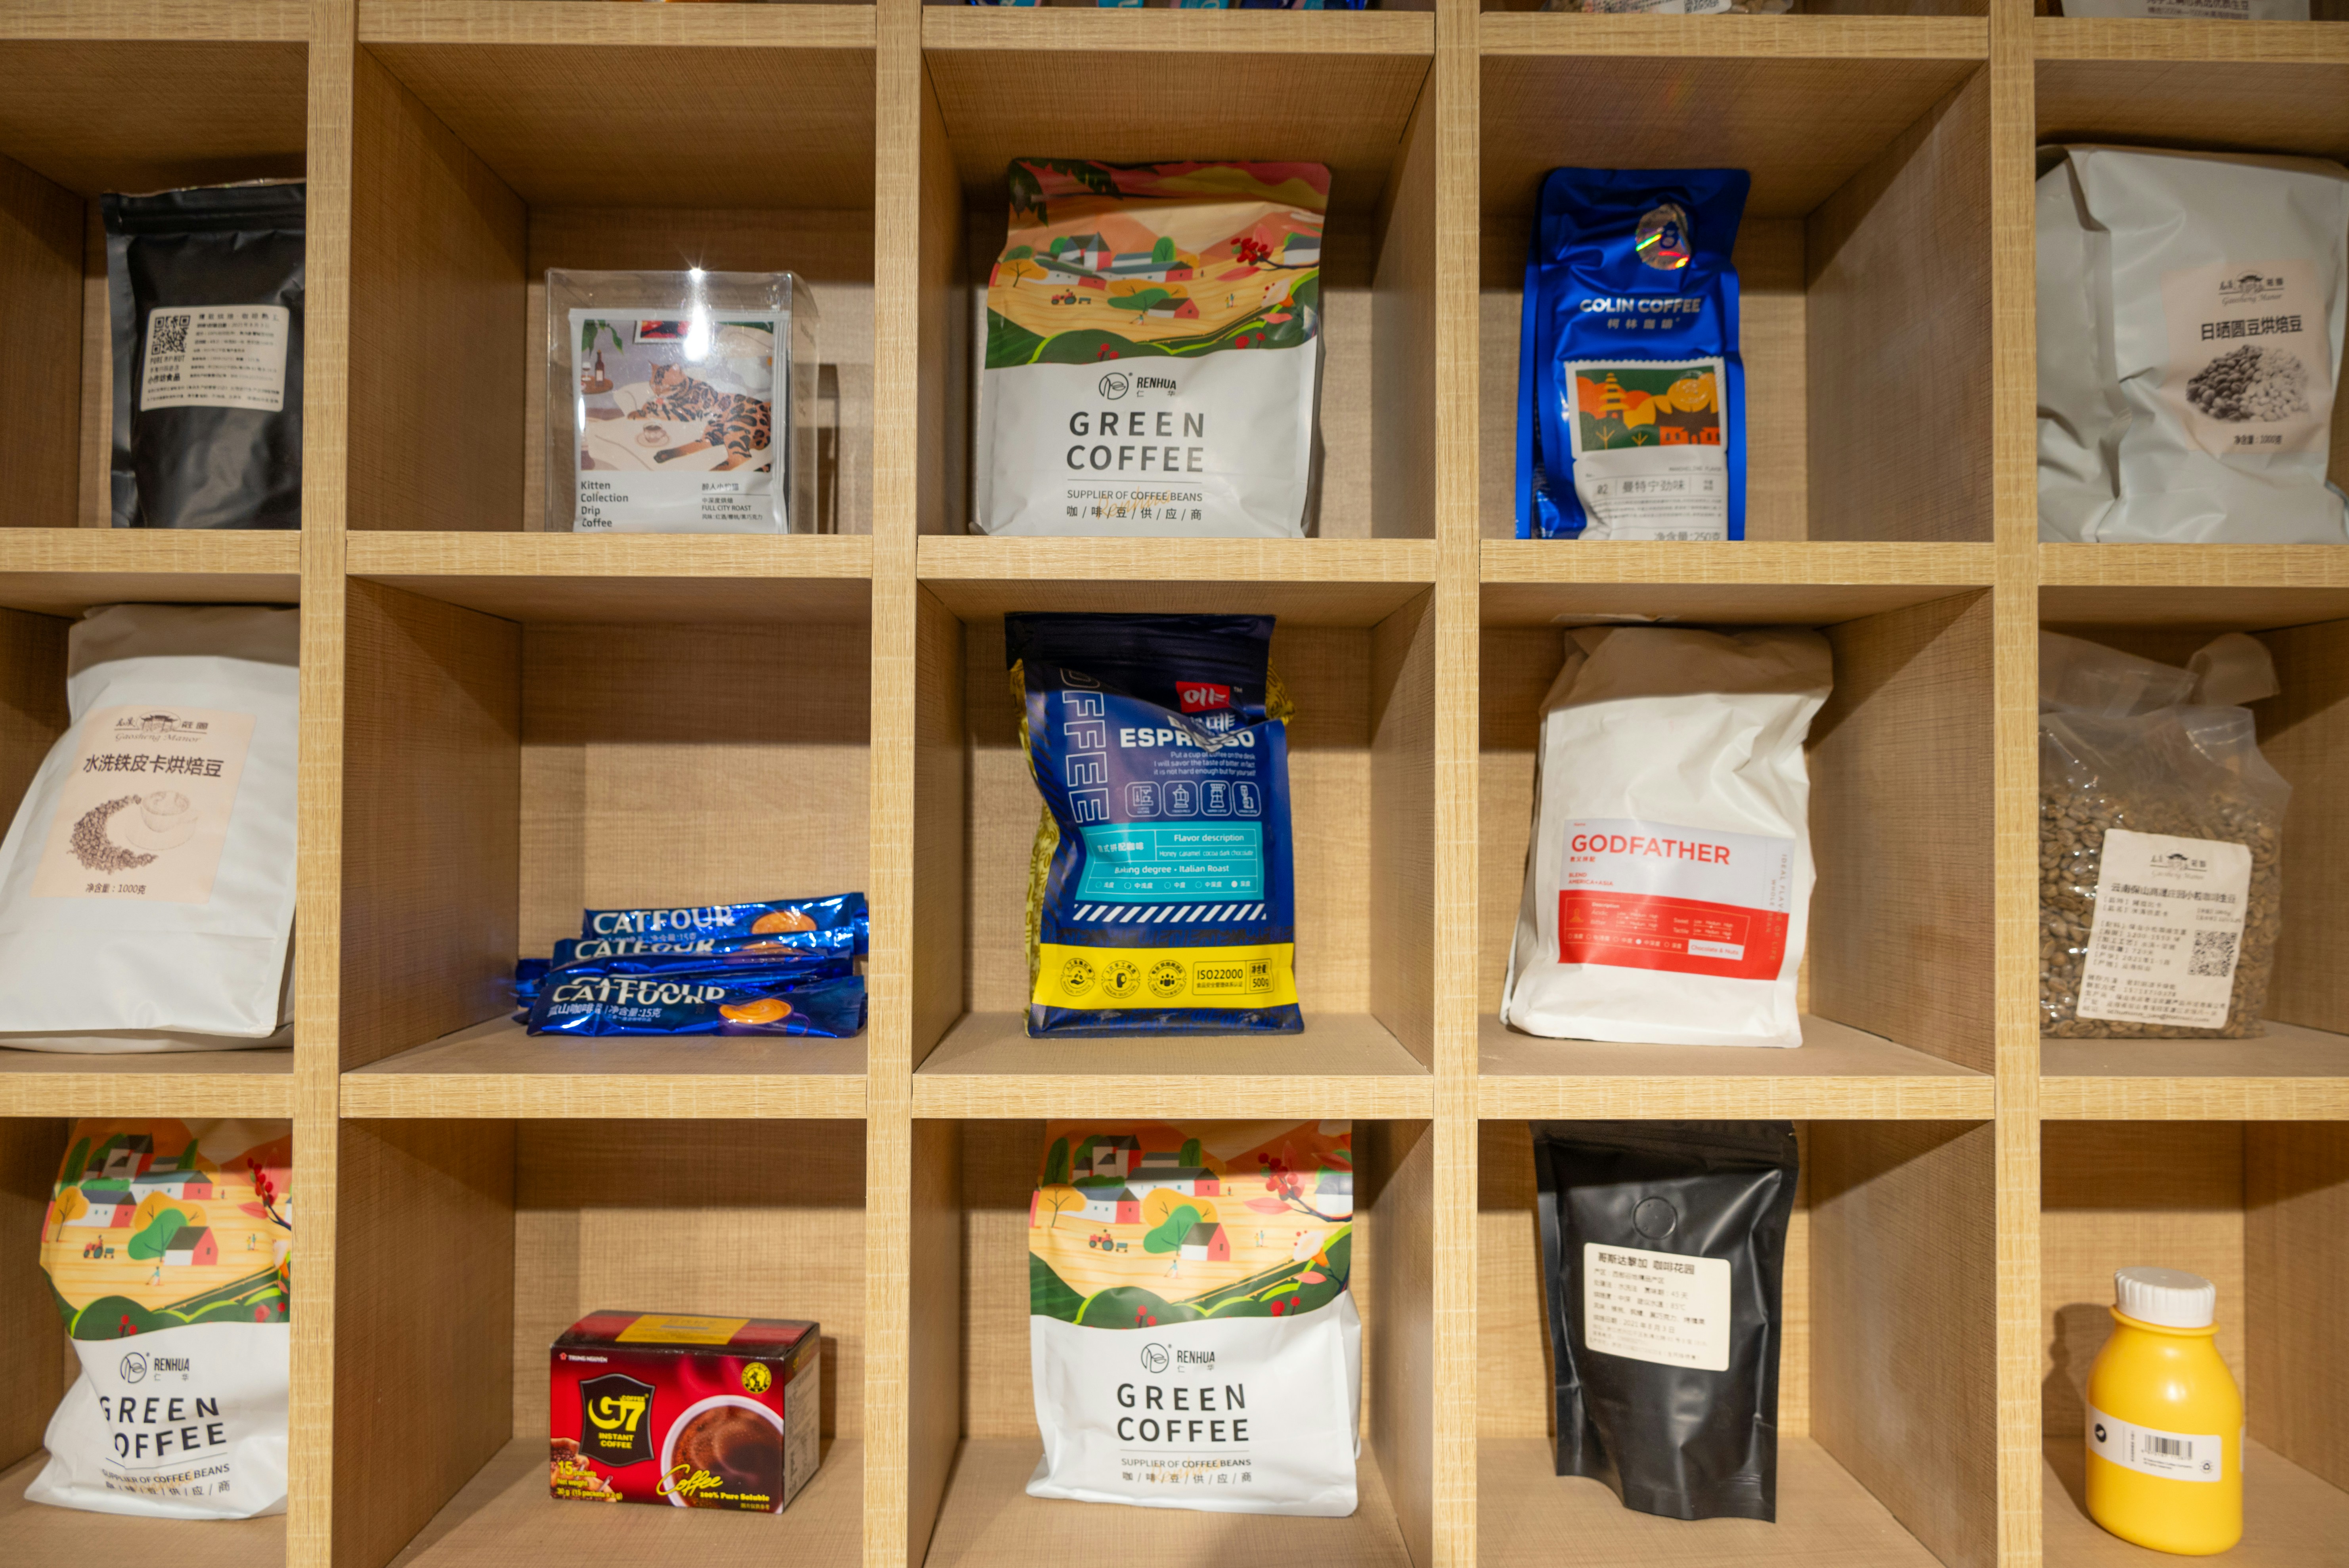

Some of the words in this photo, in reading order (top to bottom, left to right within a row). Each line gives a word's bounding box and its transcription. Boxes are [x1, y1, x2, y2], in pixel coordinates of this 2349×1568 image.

[1579, 298, 1635, 313] COLIN
[1637, 298, 1701, 313] COFFEE
[1136, 377, 1176, 390] RENHUA
[1069, 411, 1204, 438] GREEN
[1066, 444, 1204, 472] COFFEE
[581, 481, 611, 490] Kitten
[581, 493, 629, 502] Collection
[1067, 490, 1113, 499] SUPPLIER
[1116, 491, 1129, 499] OF
[1131, 491, 1167, 501] COFFEE
[1170, 493, 1203, 501] BEANS
[581, 506, 601, 516] Drip
[582, 518, 612, 527] Coffee
[82, 754, 224, 777] 水洗铁皮卡烘焙豆
[1201, 834, 1244, 843] description
[1571, 834, 1731, 865] GODFATHER
[1114, 866, 1140, 874] Baking
[1142, 866, 1172, 875] degree
[593, 906, 736, 934] CATFOUR
[1197, 969, 1243, 980] ISO22000
[1253, 978, 1269, 988] 500g
[608, 1005, 662, 1018] 净含量:15克
[1653, 1260, 1695, 1275] 咖啡花园
[1176, 1350, 1216, 1364] RENHUA
[154, 1358, 190, 1371] RENHUA
[1117, 1383, 1246, 1411] GREEN
[588, 1396, 646, 1432] G7
[1117, 1417, 1249, 1442] COFFEE
[114, 1422, 227, 1459] OFFEE
[598, 1432, 634, 1442] INSTANT
[600, 1440, 632, 1449] COFFEE
[558, 1460, 573, 1475] 15
[574, 1469, 597, 1478] packets
[1121, 1458, 1165, 1467] SUPPLIER
[102, 1469, 138, 1483] SUPPLIER
[153, 1472, 191, 1483] COFFEE
[193, 1463, 230, 1479] BEANS
[568, 1479, 589, 1488] weight
[656, 1464, 723, 1497] Coffee
[720, 1492, 739, 1500] Pure
[740, 1493, 770, 1502] Soluble
